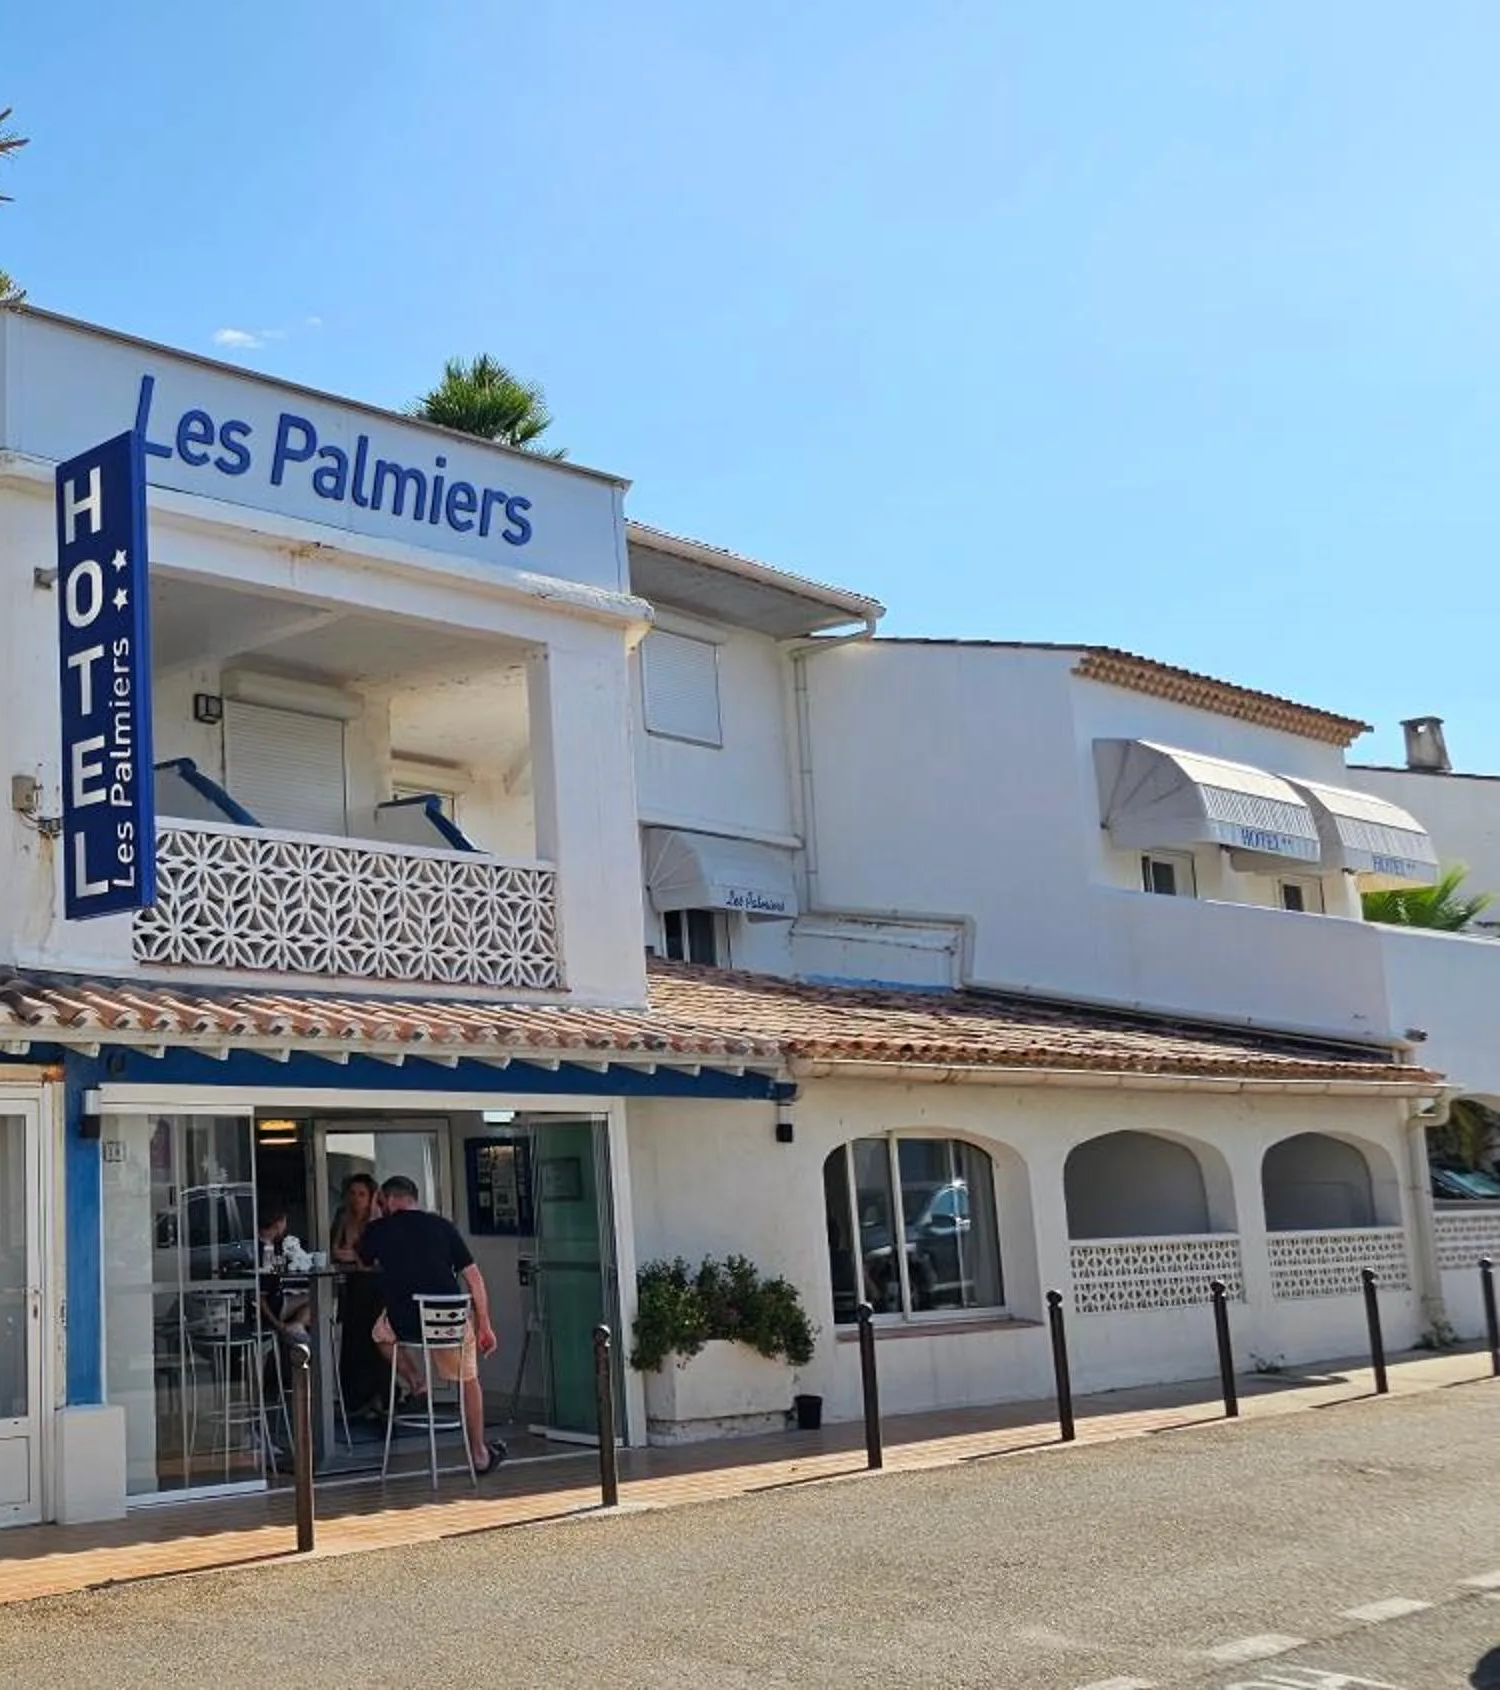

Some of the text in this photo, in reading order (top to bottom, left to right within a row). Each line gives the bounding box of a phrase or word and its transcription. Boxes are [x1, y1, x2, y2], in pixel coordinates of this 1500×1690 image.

[135, 374, 533, 546] Les Palmiers
[64, 466, 109, 898] HOTEL
[109, 637, 135, 888] Les Palmiers
